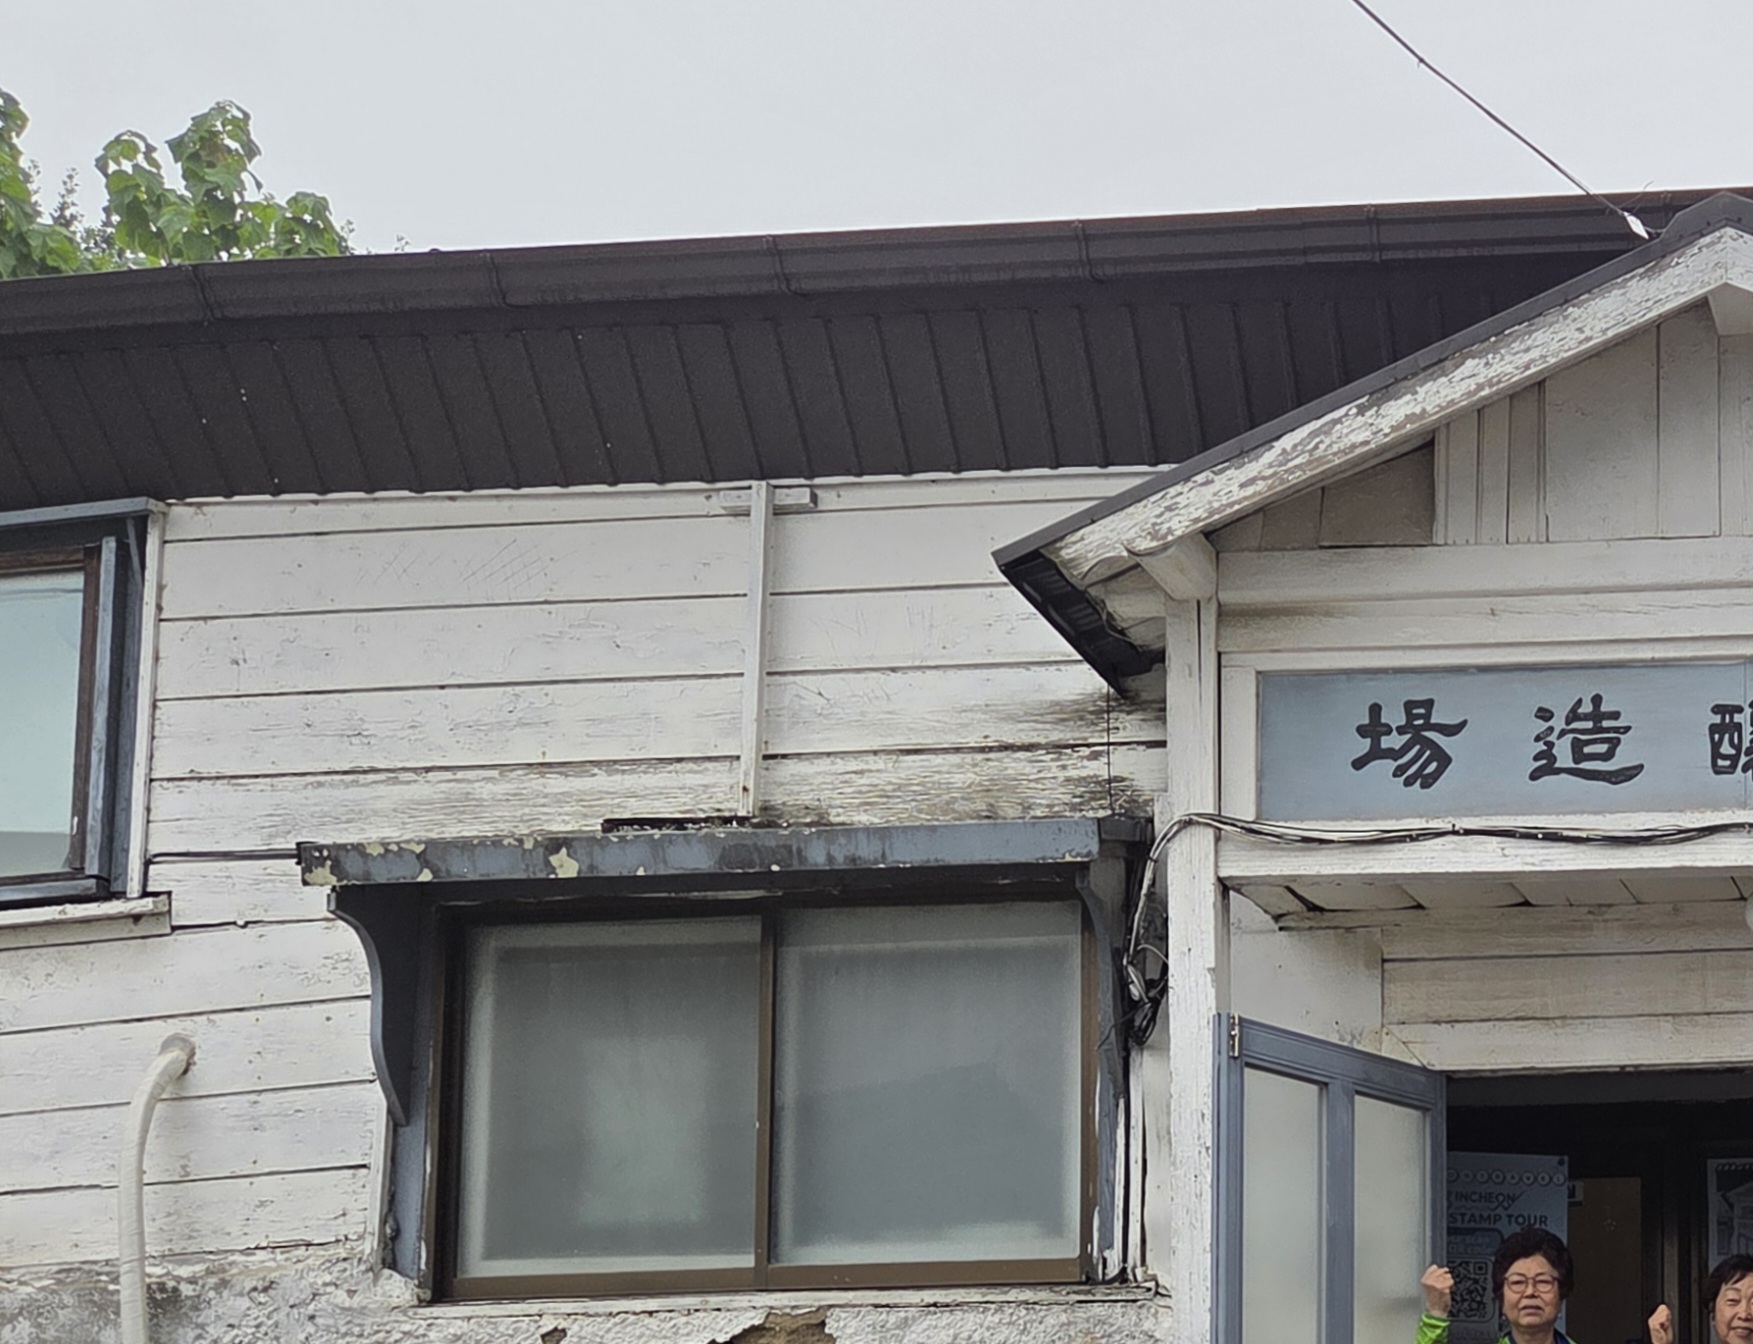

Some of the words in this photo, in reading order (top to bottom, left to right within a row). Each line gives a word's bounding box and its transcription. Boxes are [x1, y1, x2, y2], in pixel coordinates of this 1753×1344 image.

[1455, 1190, 1517, 1206] INCHEON
[1448, 1212, 1502, 1226] STAMP
[1506, 1213, 1549, 1227] TOUR
